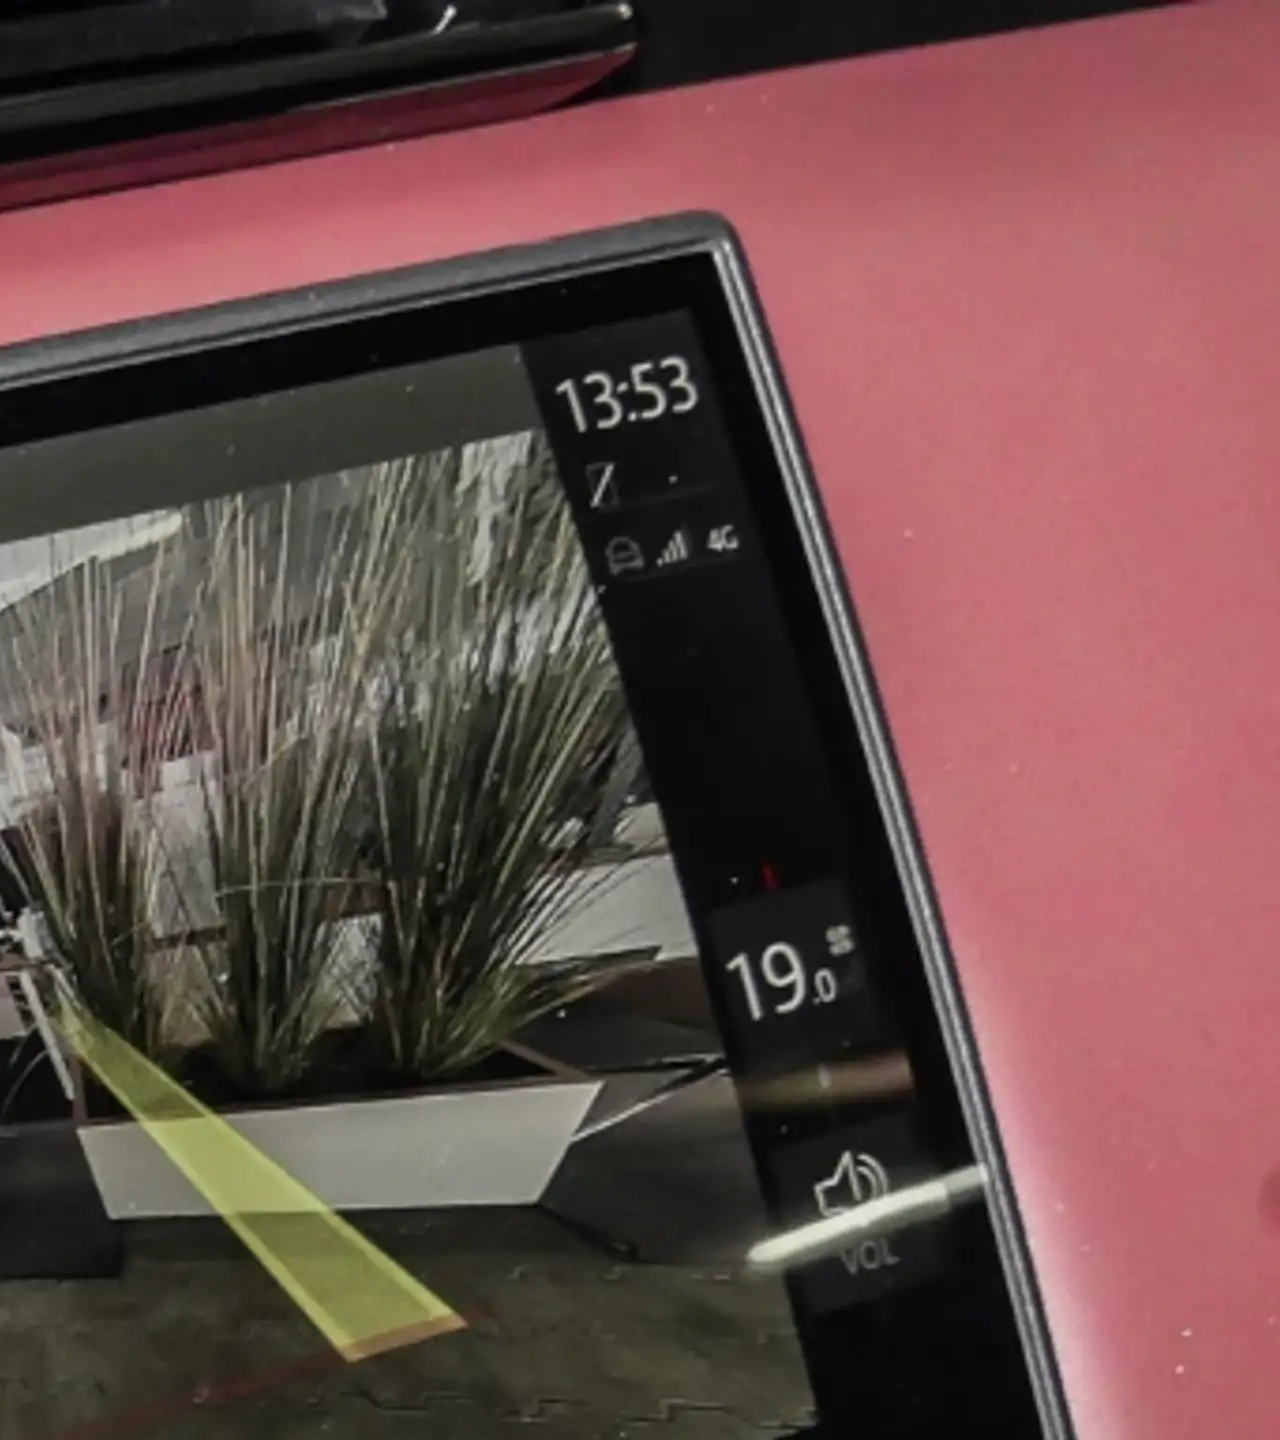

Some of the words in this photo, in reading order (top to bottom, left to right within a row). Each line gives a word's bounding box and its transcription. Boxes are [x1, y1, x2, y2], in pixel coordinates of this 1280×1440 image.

[554, 355, 700, 434] 13:53
[706, 525, 739, 553] 4G
[839, 1238, 901, 1276] VOL
